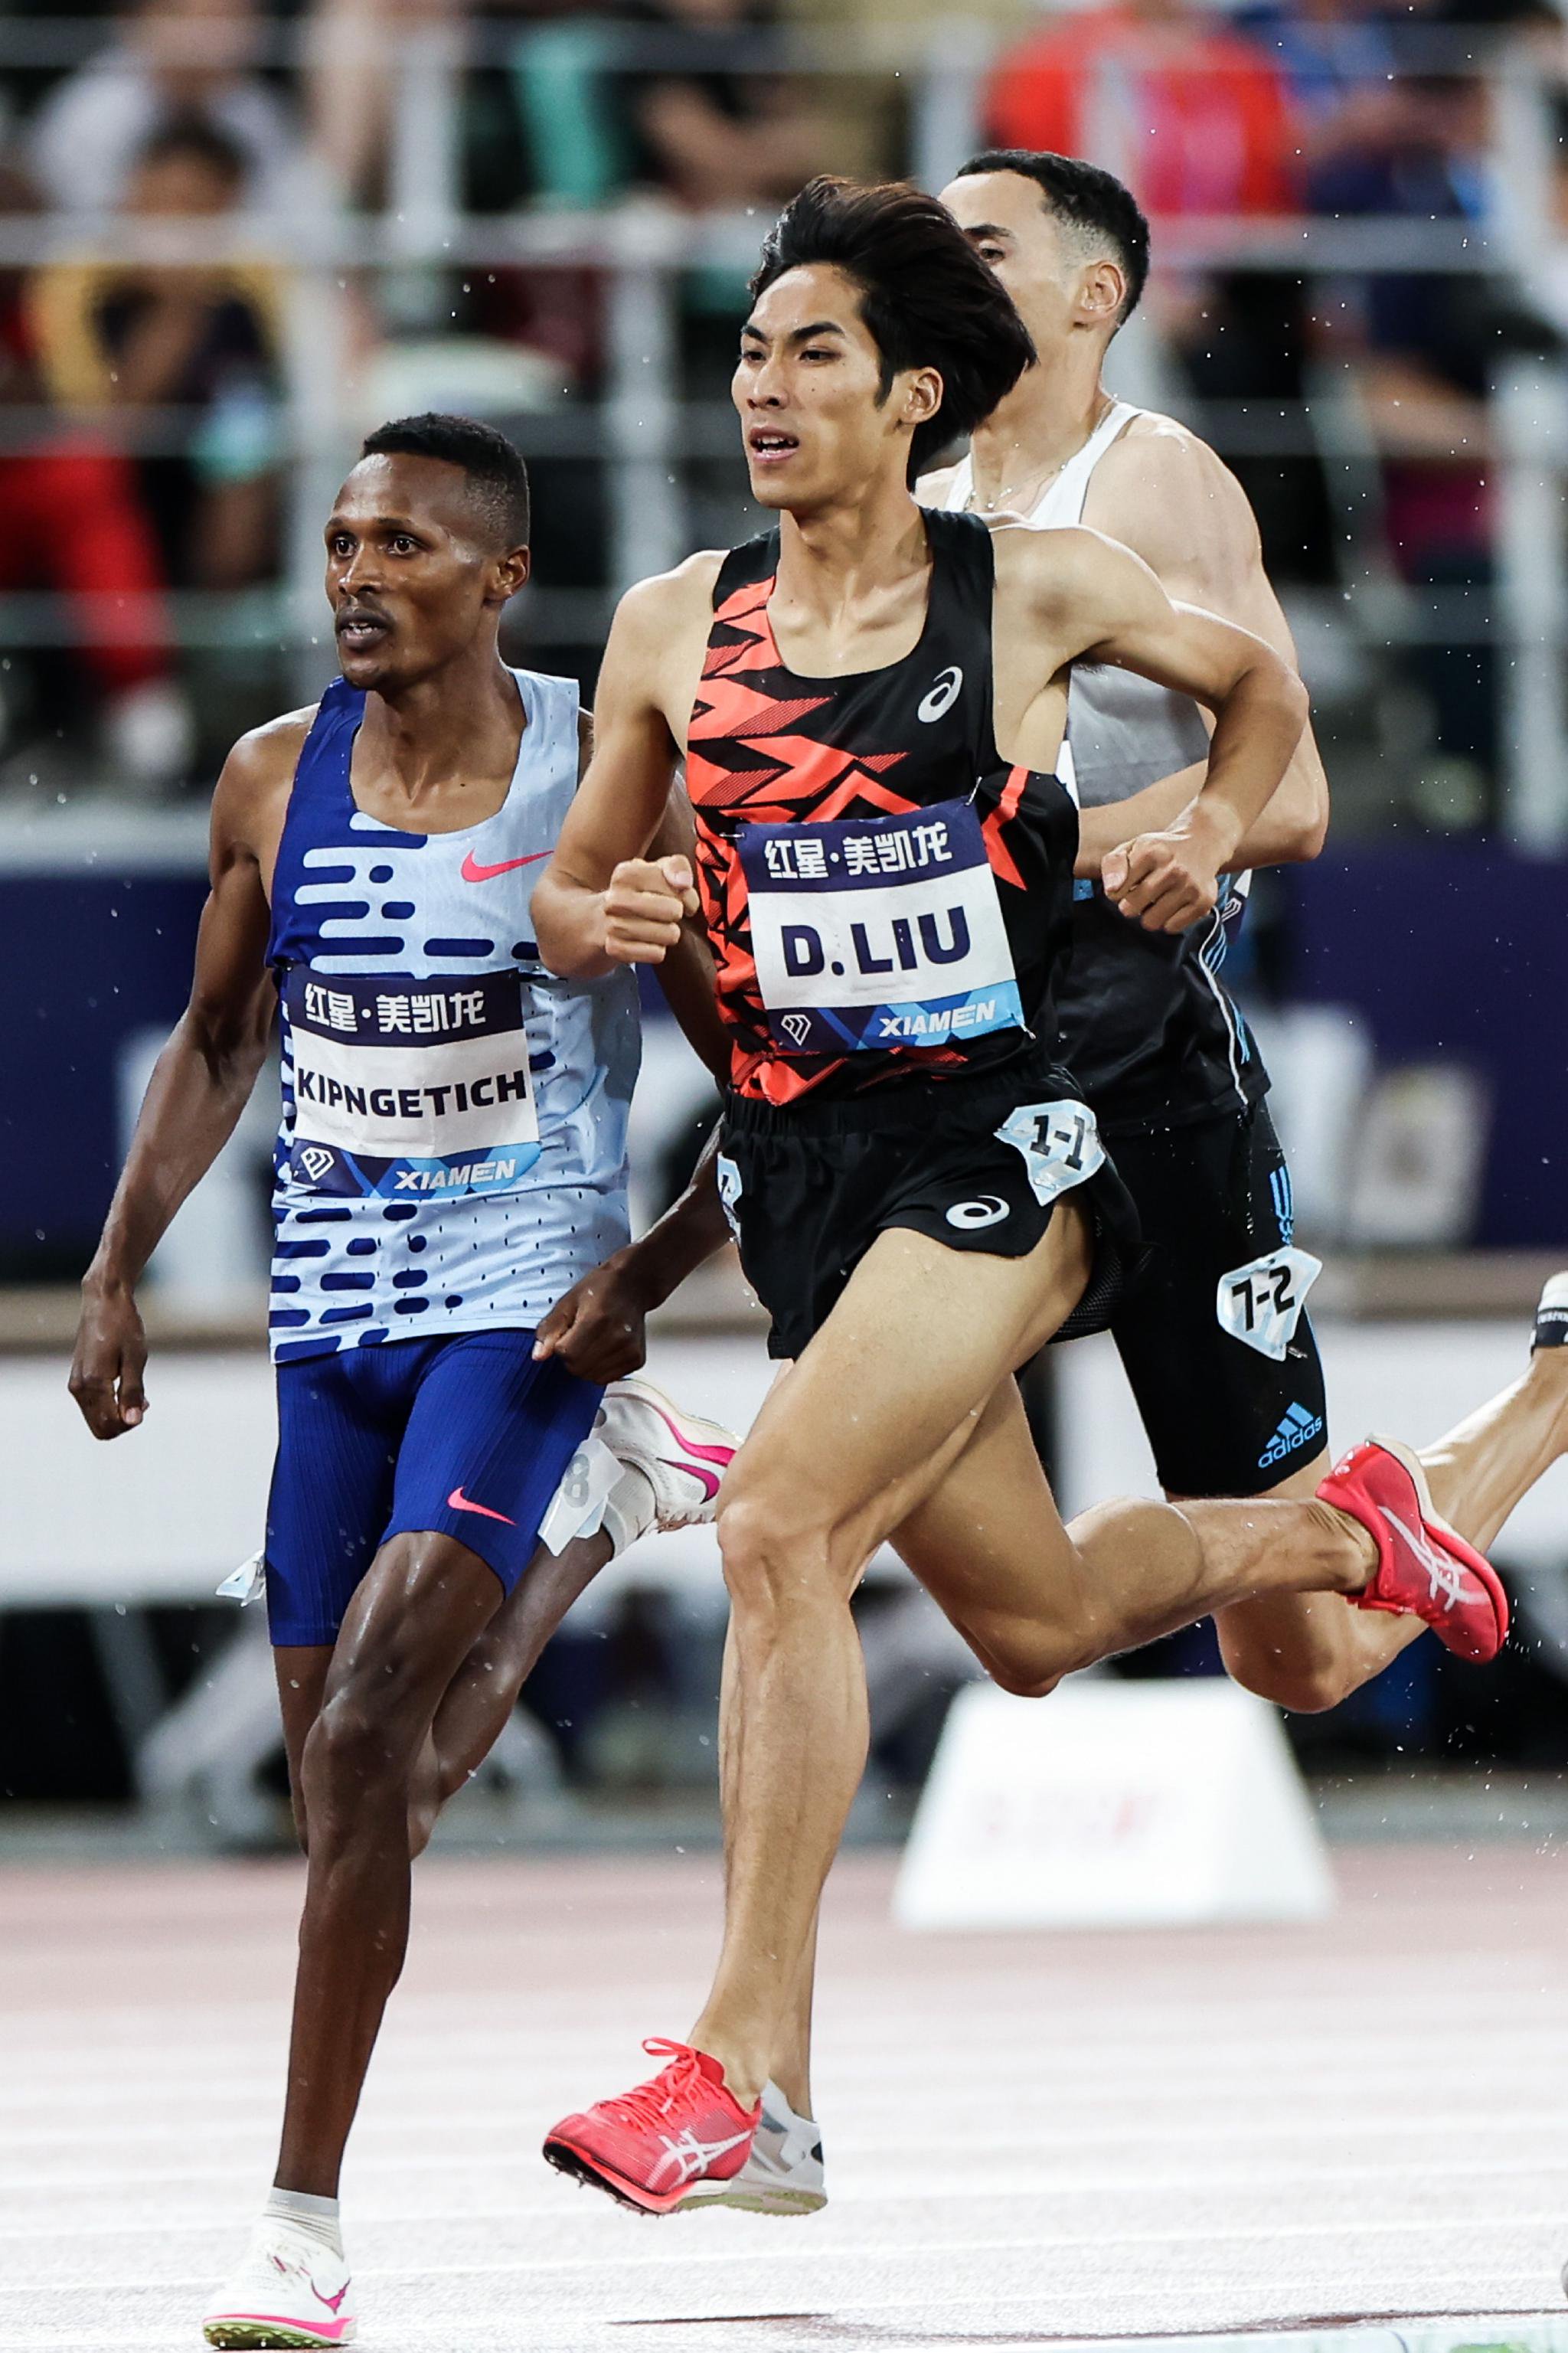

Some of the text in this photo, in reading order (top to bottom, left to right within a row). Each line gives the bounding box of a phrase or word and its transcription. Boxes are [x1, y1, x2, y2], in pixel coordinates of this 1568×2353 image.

[781, 905, 972, 977] D.LIU
[879, 1000, 996, 1038] XIAMEN
[297, 1067, 527, 1118] KIPNGETICH
[1030, 1114, 1086, 1171] 1-1
[394, 1159, 516, 1190] XIAMEN
[1231, 1265, 1295, 1332] 7-2
[1258, 1415, 1323, 1469] adidas
